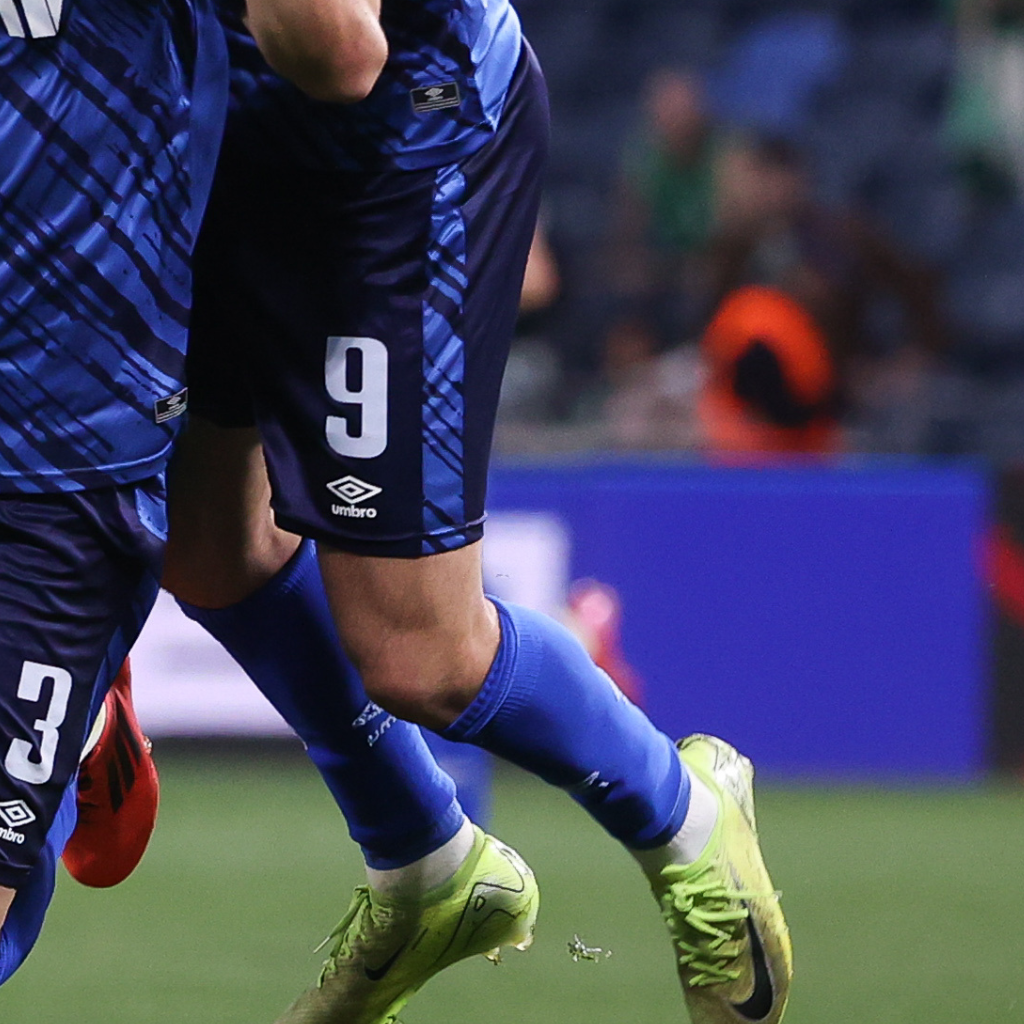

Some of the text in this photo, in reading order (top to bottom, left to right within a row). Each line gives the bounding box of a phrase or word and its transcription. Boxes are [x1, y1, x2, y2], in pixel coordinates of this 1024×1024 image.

[325, 336, 388, 459] 9
[331, 503, 377, 519] umbro
[4, 660, 72, 785] 3
